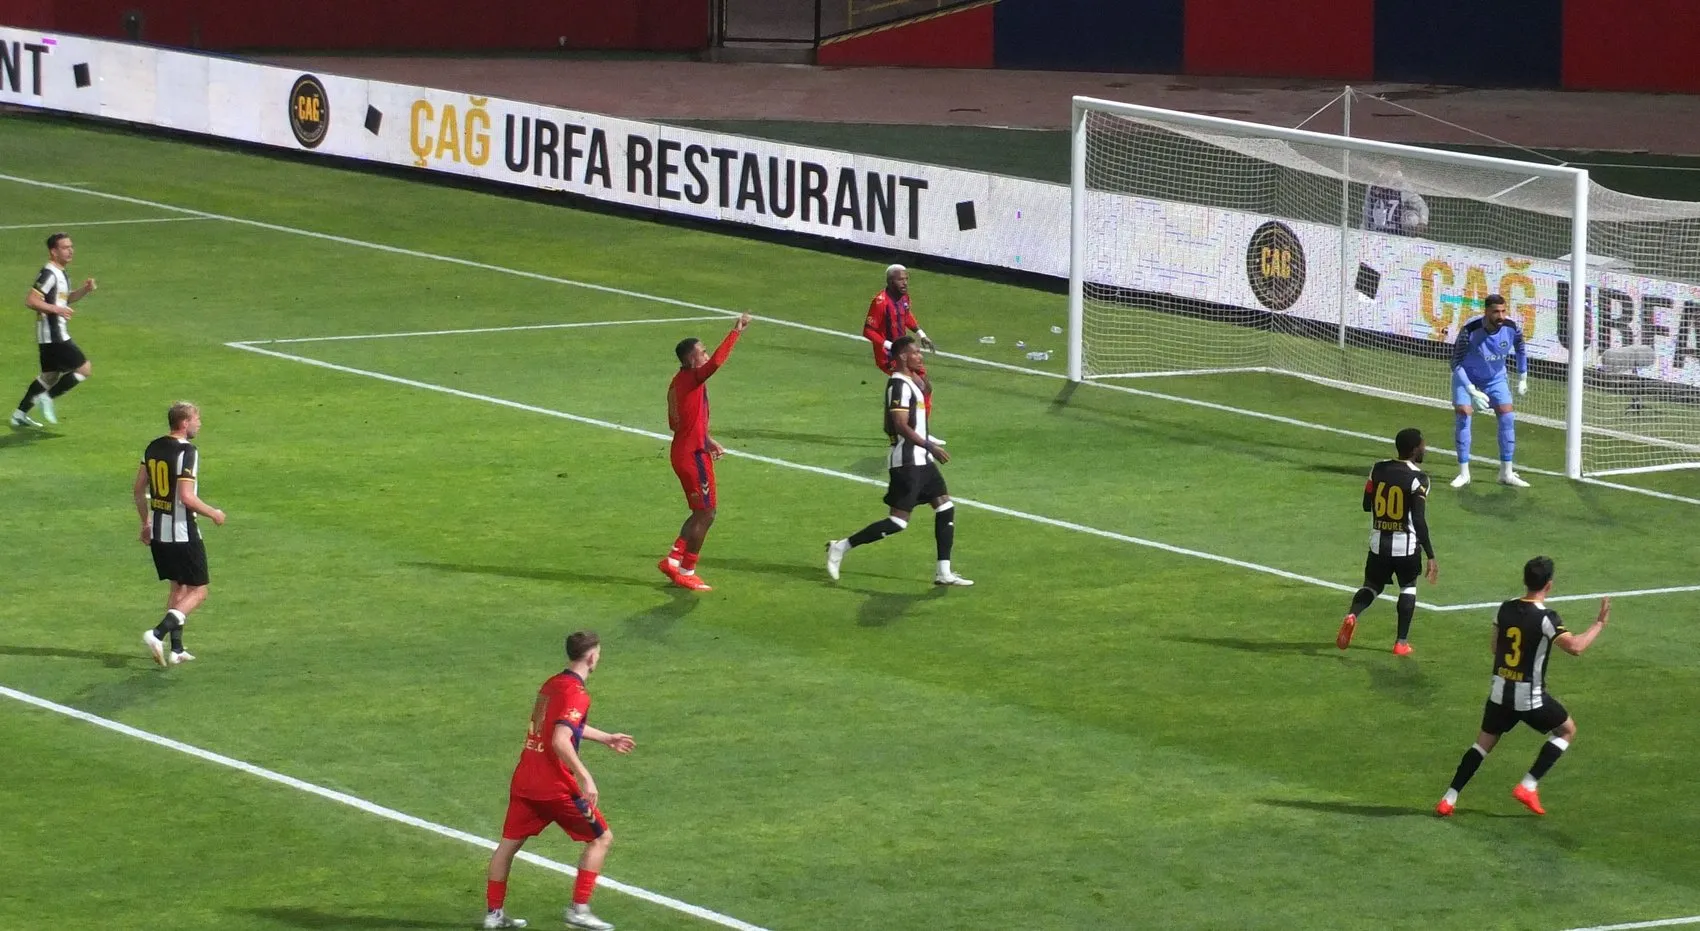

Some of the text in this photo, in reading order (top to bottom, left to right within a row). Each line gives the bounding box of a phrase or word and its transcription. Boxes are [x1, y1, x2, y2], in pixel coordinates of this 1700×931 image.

[410, 96, 928, 240] ÇAĞ URFA RESTAURANT
[1421, 257, 1536, 341] ÇAĞ
[148, 458, 170, 497] 10
[1375, 481, 1404, 520] 60
[1504, 626, 1522, 667] 3
